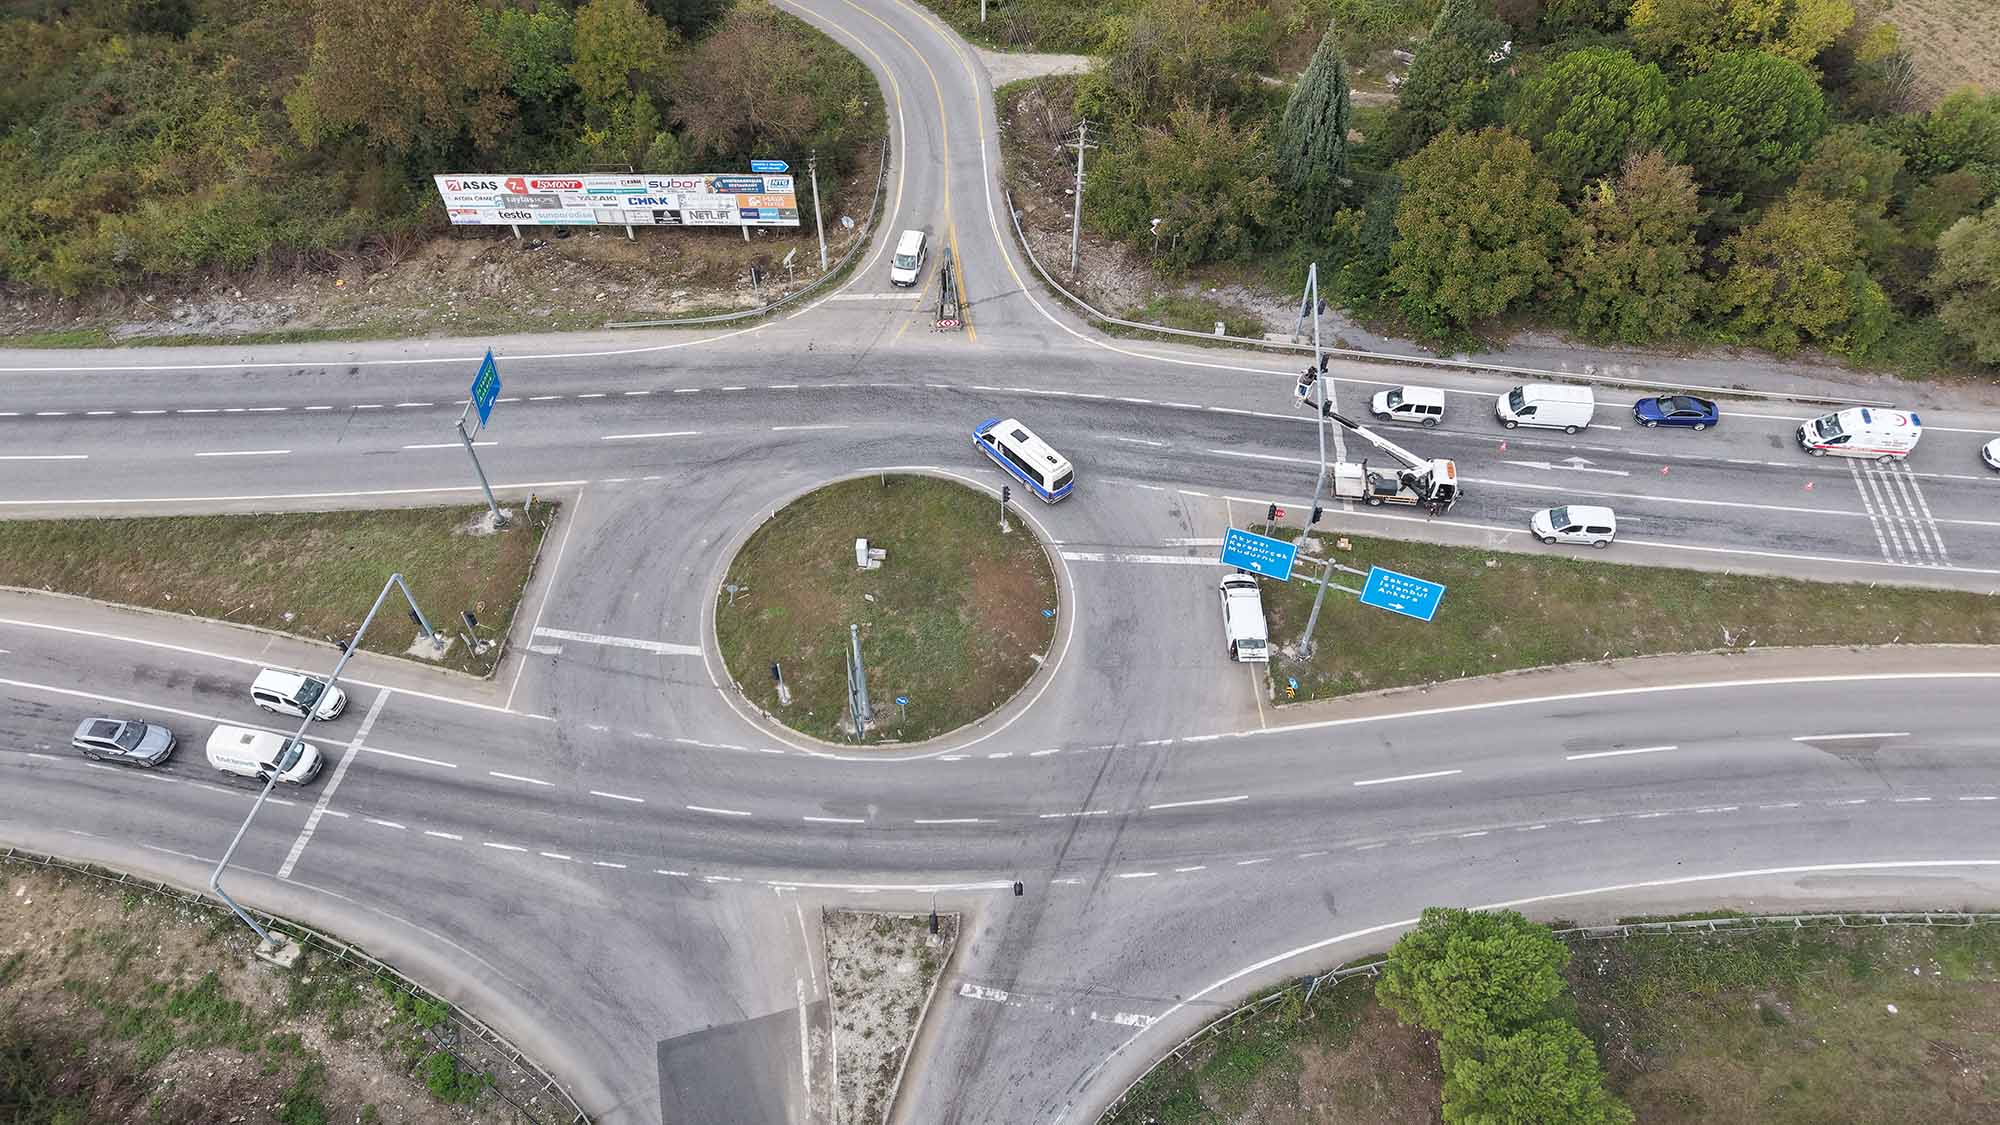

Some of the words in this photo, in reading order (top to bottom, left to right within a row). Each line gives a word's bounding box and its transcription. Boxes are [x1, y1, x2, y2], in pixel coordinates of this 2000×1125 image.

[648, 178, 702, 188] subor
[1382, 575, 1428, 592] Sakarya
[1377, 587, 1418, 602] Ankara
